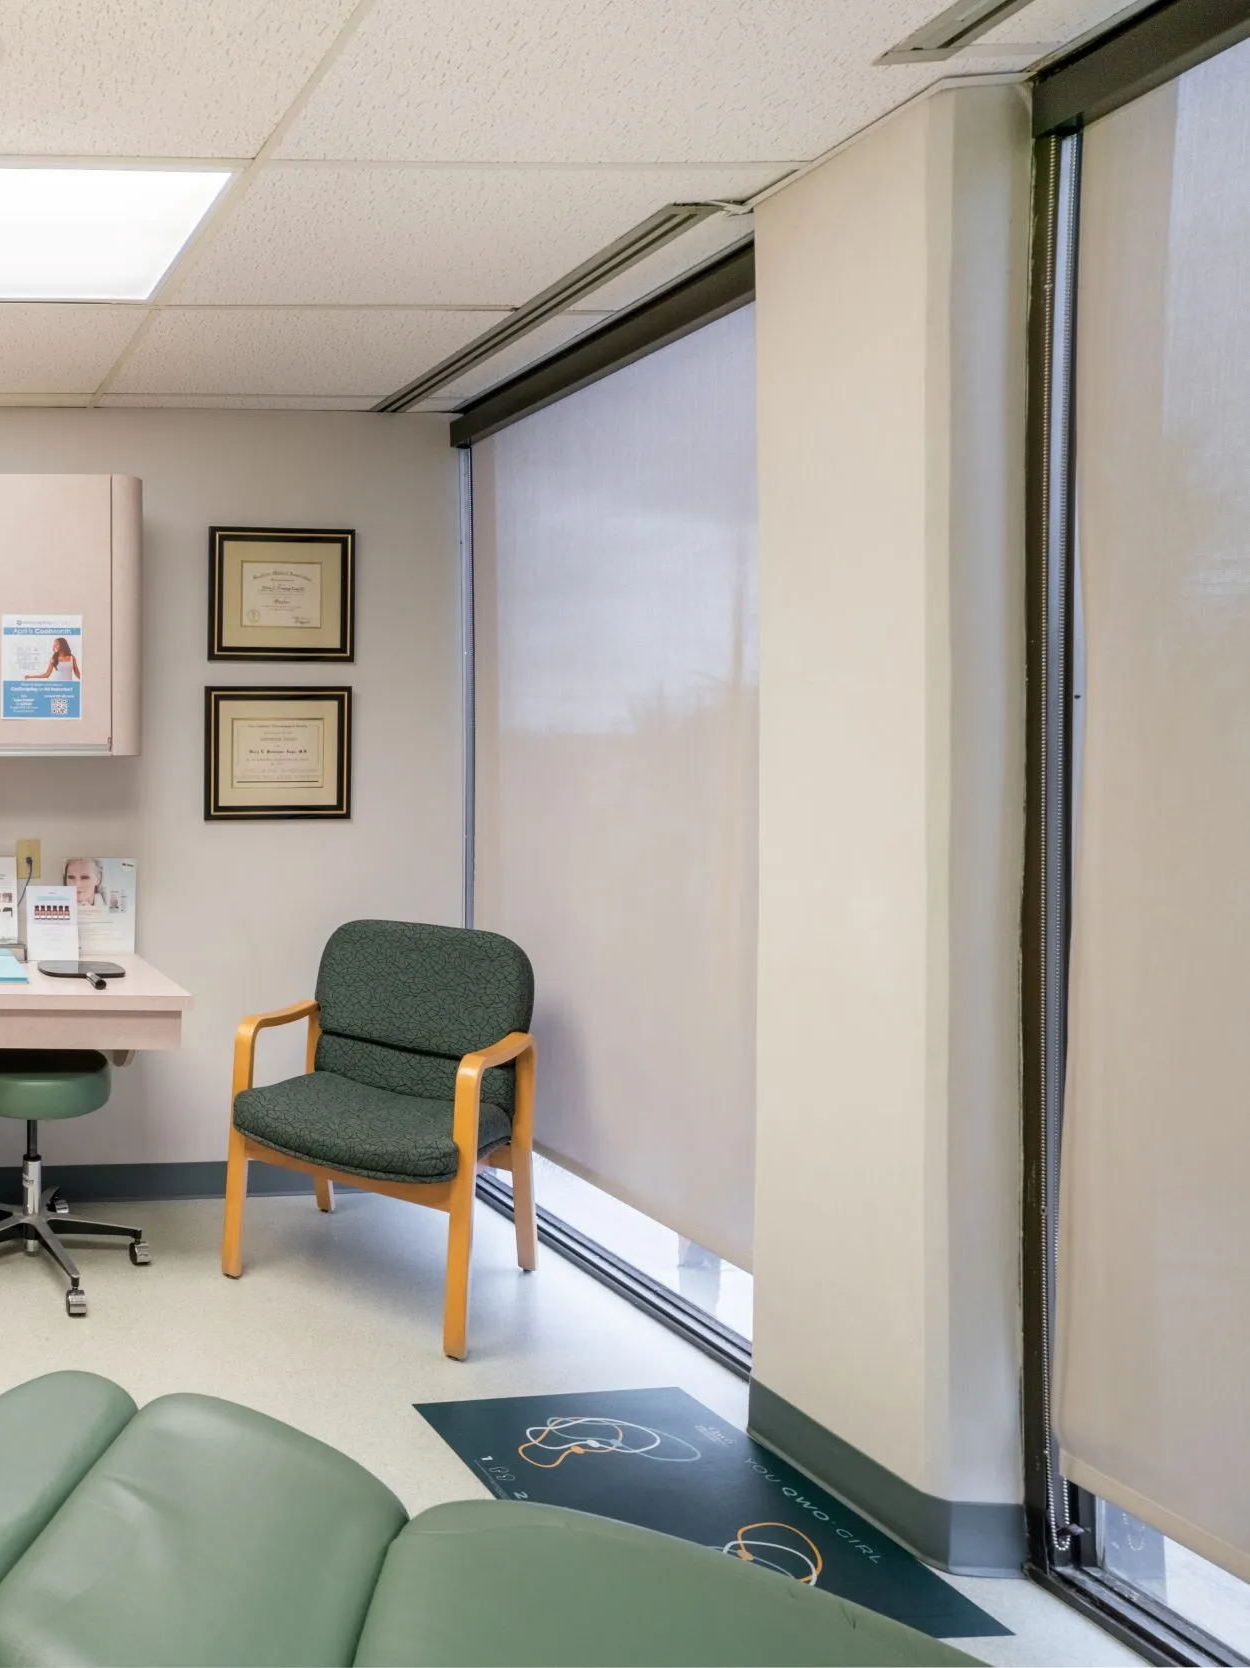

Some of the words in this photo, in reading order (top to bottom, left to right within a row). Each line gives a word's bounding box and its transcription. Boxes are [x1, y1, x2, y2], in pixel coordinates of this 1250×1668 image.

[513, 1491, 528, 1500] 2
[744, 1457, 781, 1483] YOU
[782, 1486, 830, 1522] QWO
[835, 1528, 883, 1565] GIRL
